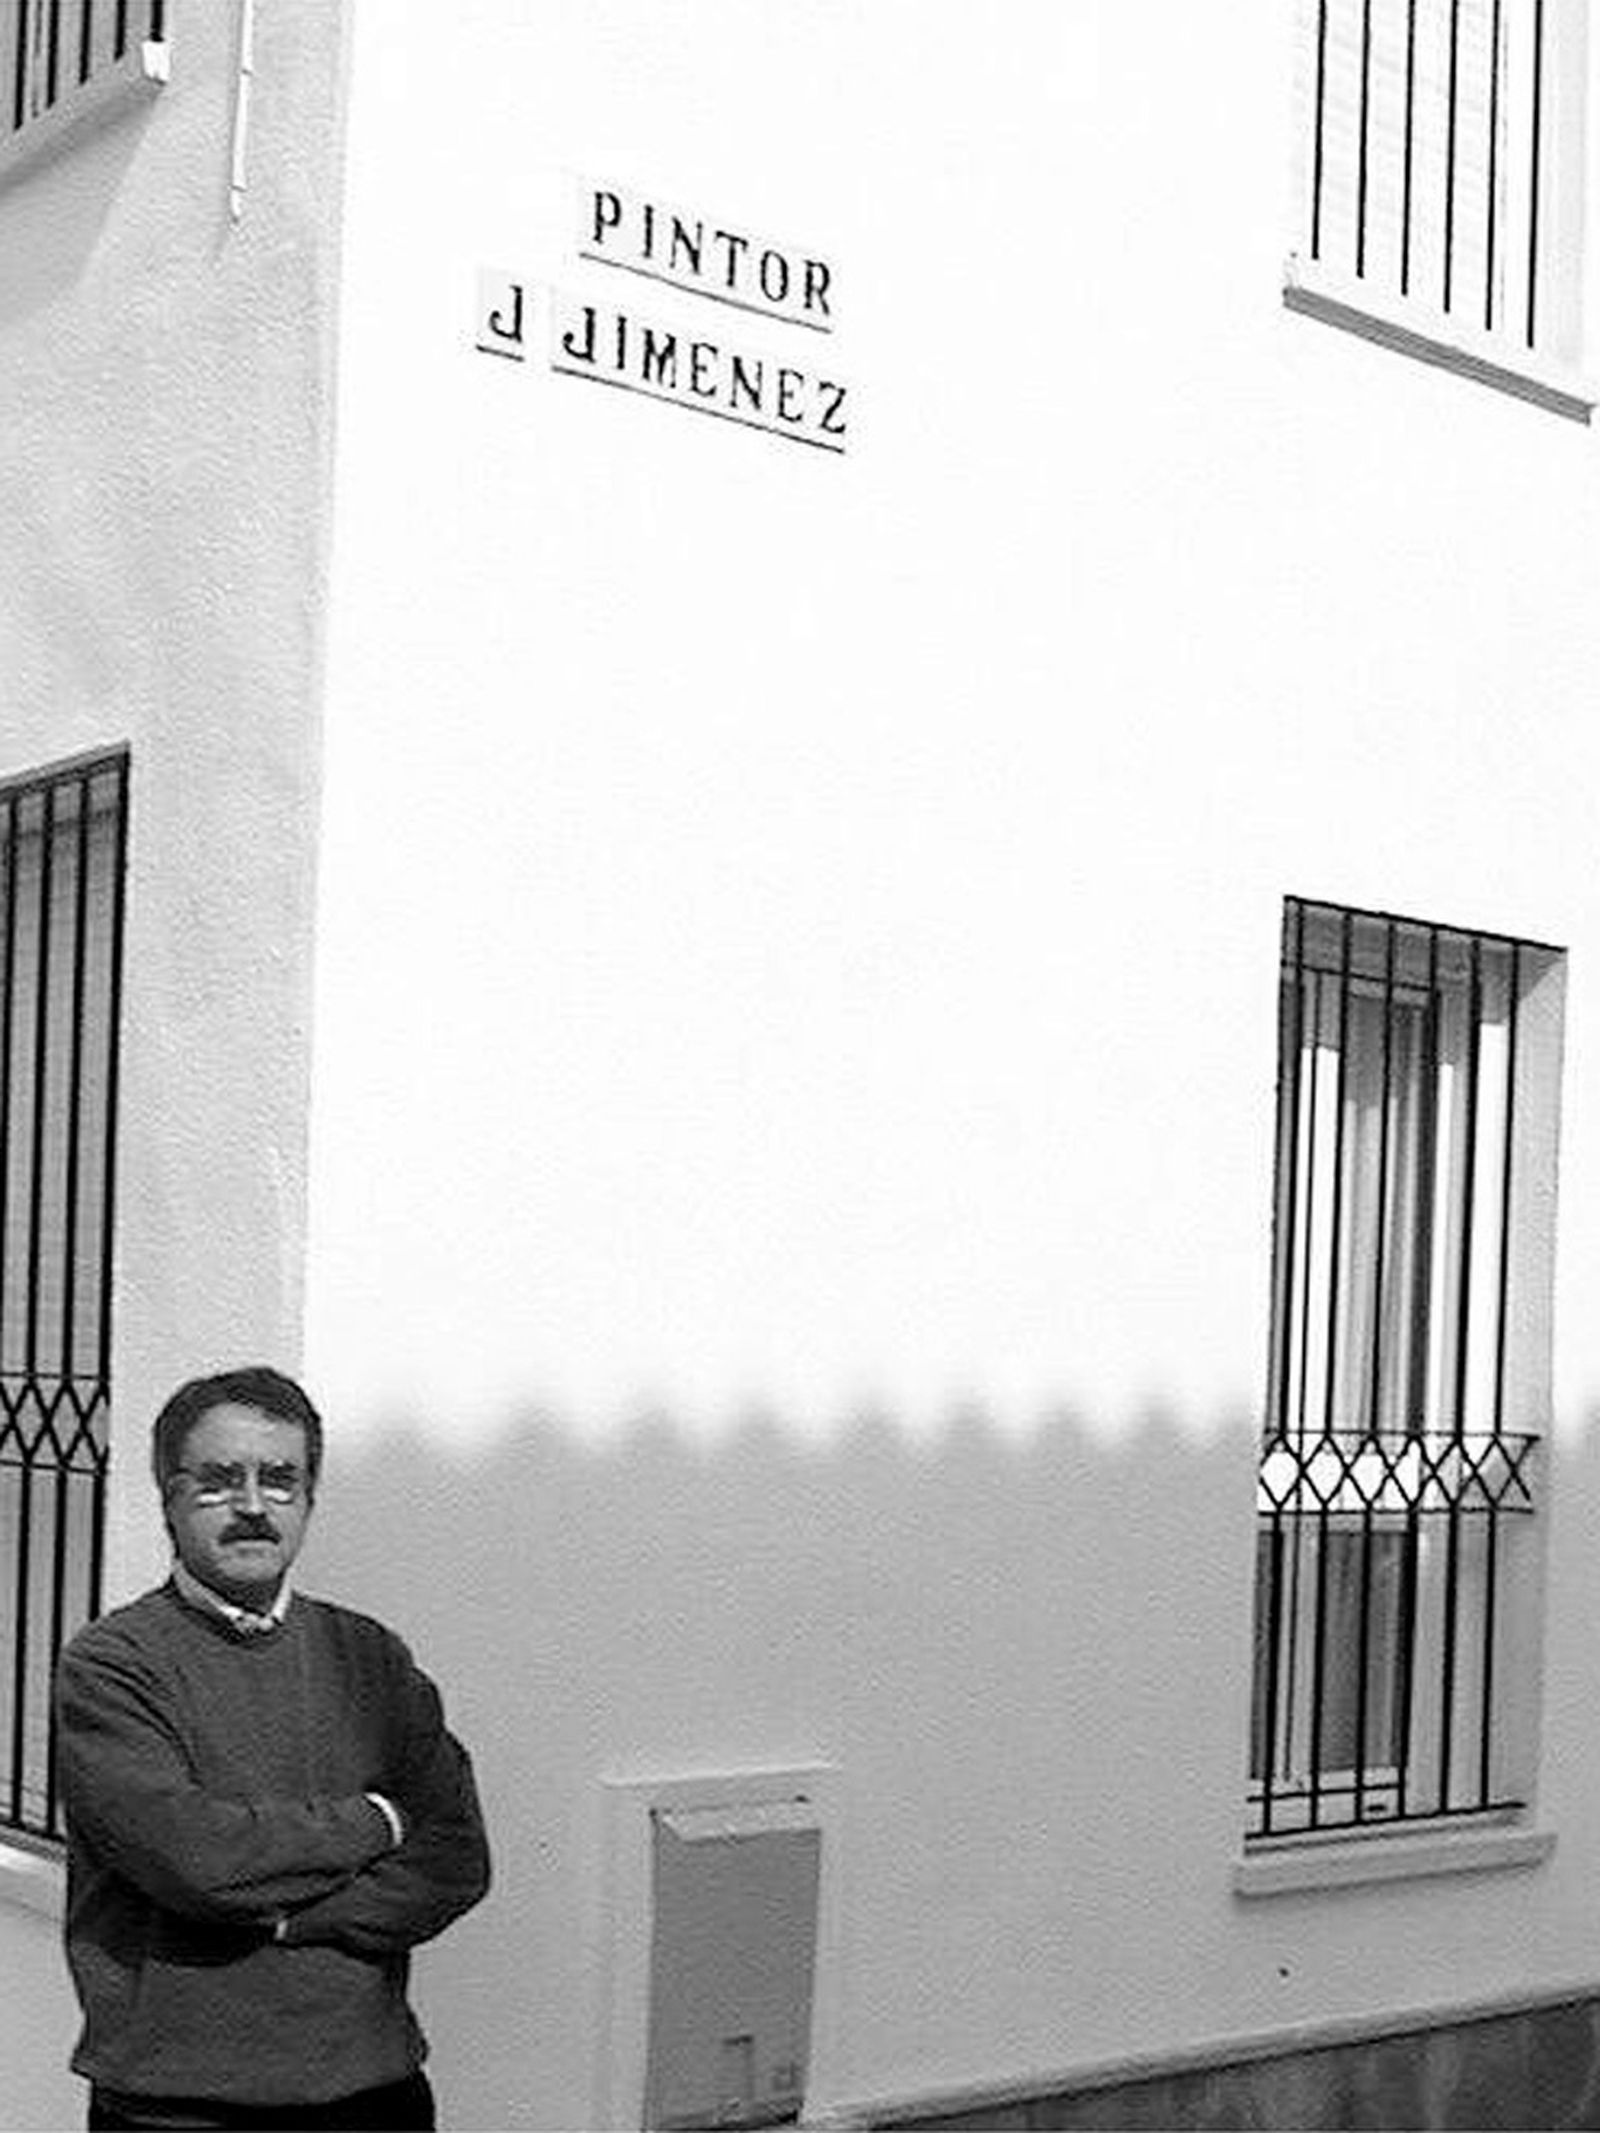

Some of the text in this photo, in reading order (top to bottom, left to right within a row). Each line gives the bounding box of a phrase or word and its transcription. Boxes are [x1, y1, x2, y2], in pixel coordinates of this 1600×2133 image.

[592, 190, 831, 316] PINTOR
[488, 285, 848, 435] J JIMENEZ
